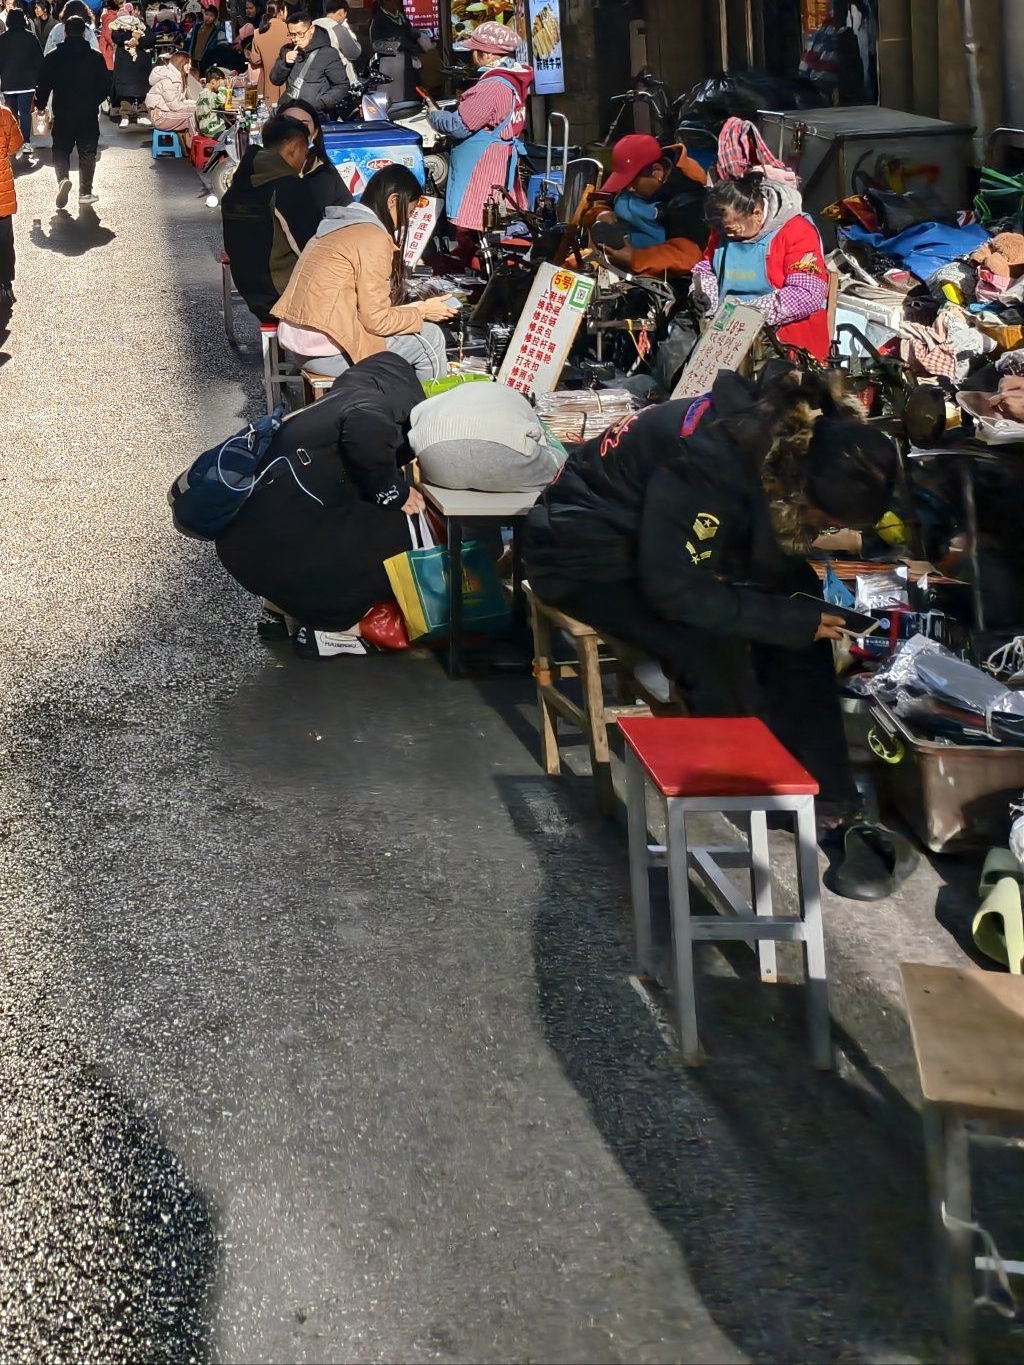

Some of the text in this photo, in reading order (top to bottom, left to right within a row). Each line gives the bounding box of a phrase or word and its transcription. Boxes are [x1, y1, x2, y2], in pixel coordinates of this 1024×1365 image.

[554, 274, 572, 289] 5号
[533, 310, 557, 328] 修拉链
[528, 321, 552, 339] 修皮包
[524, 332, 556, 353] 修拉杆箱
[520, 343, 551, 365] 修皮箱轮
[516, 355, 539, 372] 打衣扣
[511, 365, 535, 383] 修雨伞
